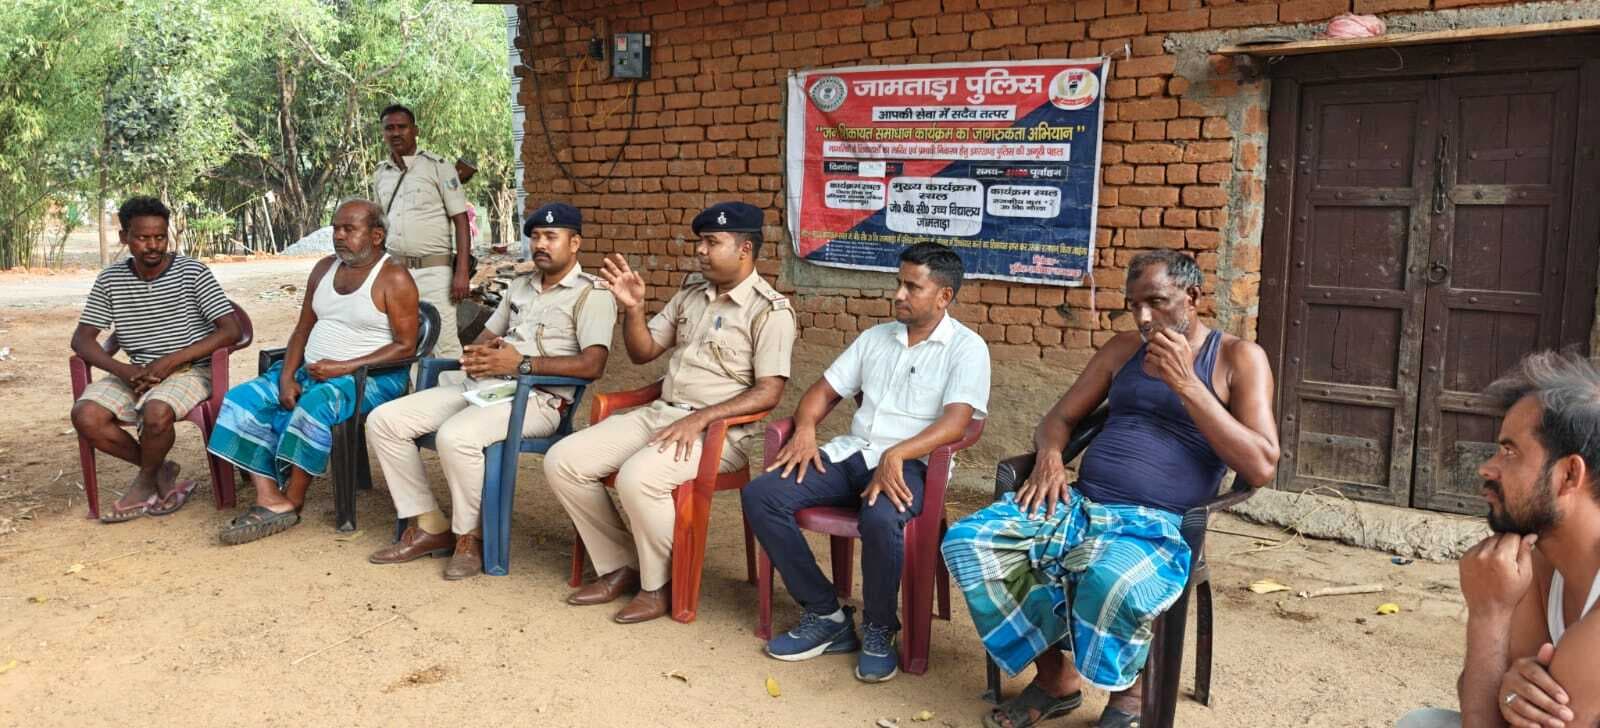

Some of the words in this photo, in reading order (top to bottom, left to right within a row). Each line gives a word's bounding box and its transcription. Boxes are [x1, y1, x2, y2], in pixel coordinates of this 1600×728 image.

[853, 77, 959, 101] जामताड़ा
[965, 69, 1044, 104] पुलिस
[878, 107, 912, 119] आपकी
[916, 108, 936, 119] सेवा
[951, 107, 976, 119] सदैव
[979, 109, 1008, 119] तत्पर
[876, 127, 912, 140] समाधान
[915, 122, 953, 141] कार्यक्रम
[956, 127, 969, 140] का
[1027, 121, 1073, 141] अभियान
[830, 181, 861, 189] कार्यक्रम
[892, 183, 921, 192] मुख्य
[925, 182, 977, 192] कार्यक्रम
[990, 186, 1030, 196] कार्यक्रम
[919, 192, 948, 200] स्थल
[931, 205, 947, 216] उच्च
[949, 202, 980, 216] विद्यालय
[916, 217, 950, 231] जामताड़ा
